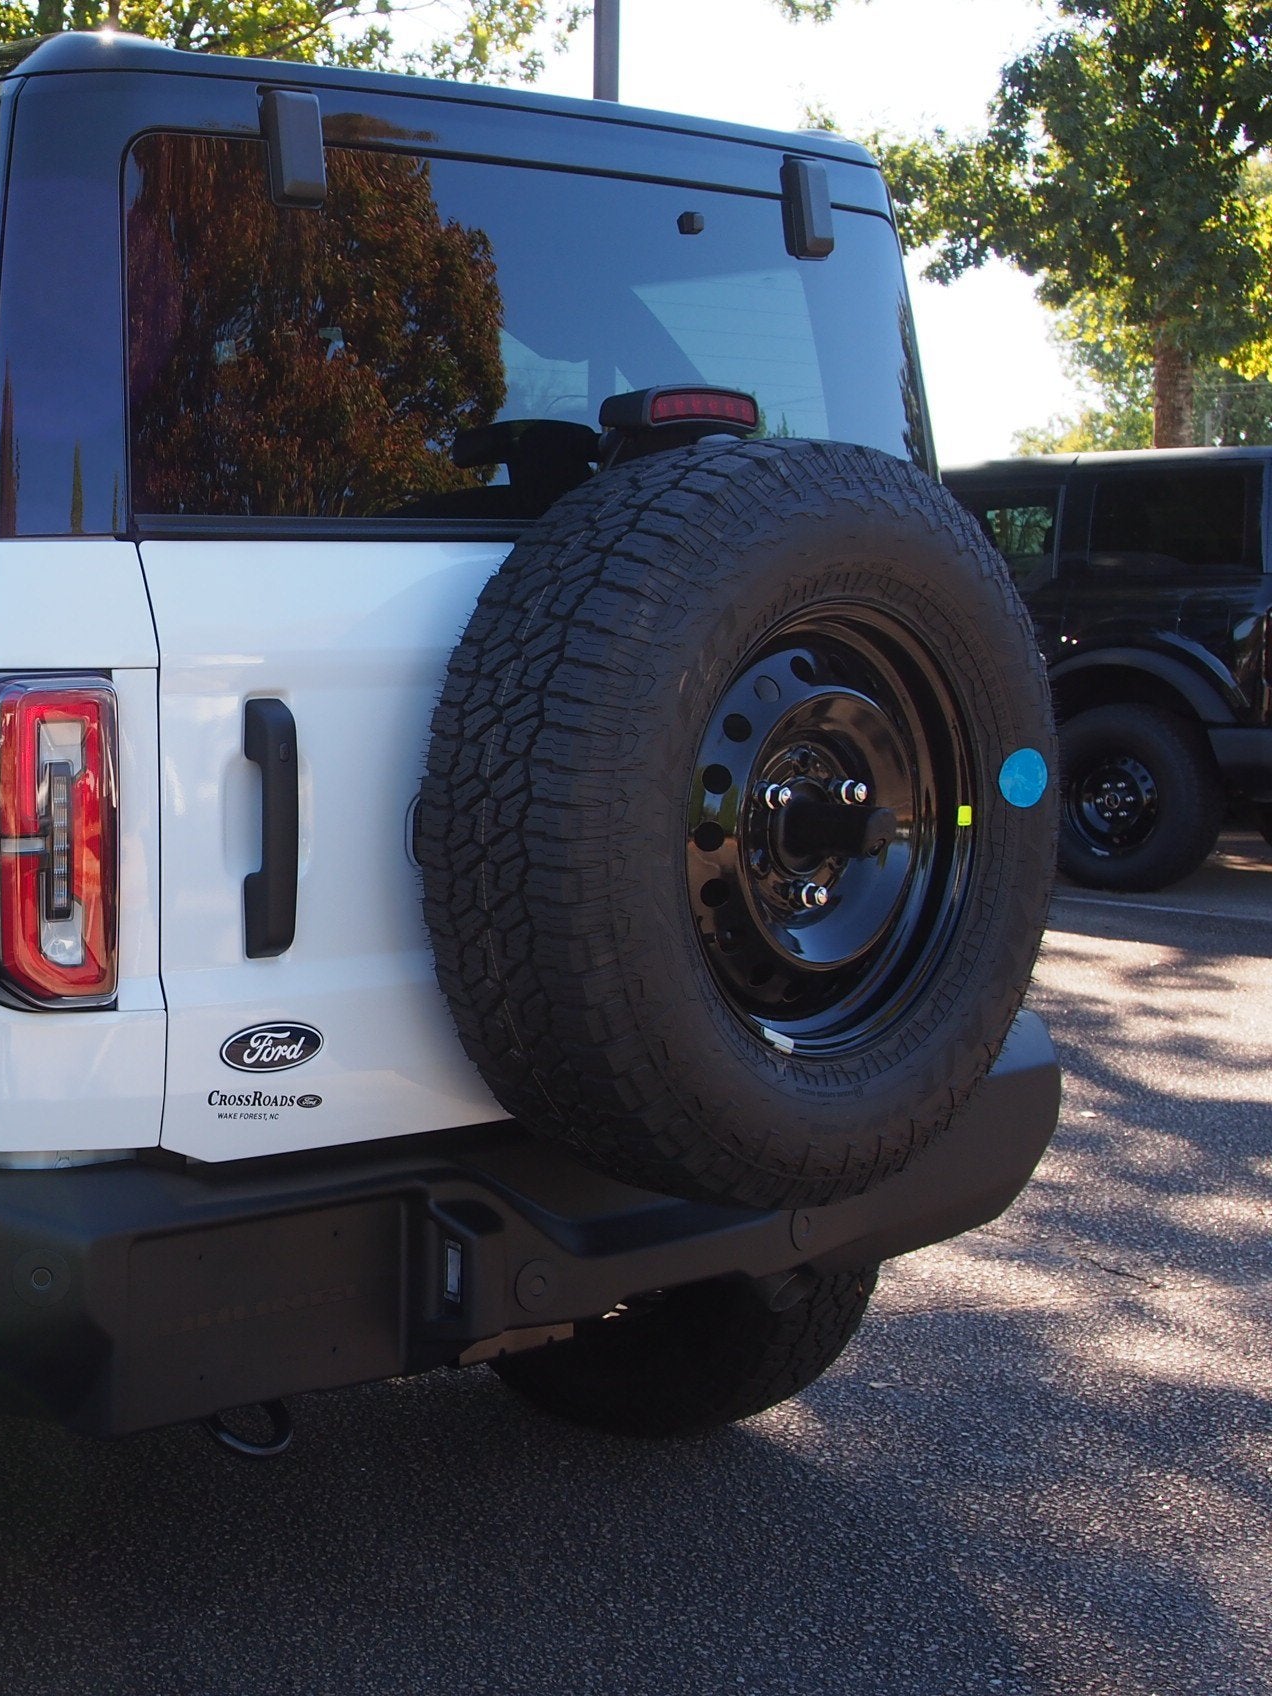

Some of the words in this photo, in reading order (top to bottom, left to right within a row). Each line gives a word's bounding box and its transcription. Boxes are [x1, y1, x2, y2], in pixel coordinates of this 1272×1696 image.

[243, 1031, 306, 1064] Ford
[217, 1112, 238, 1120] WAKE
[239, 1112, 268, 1121] FOREST,
